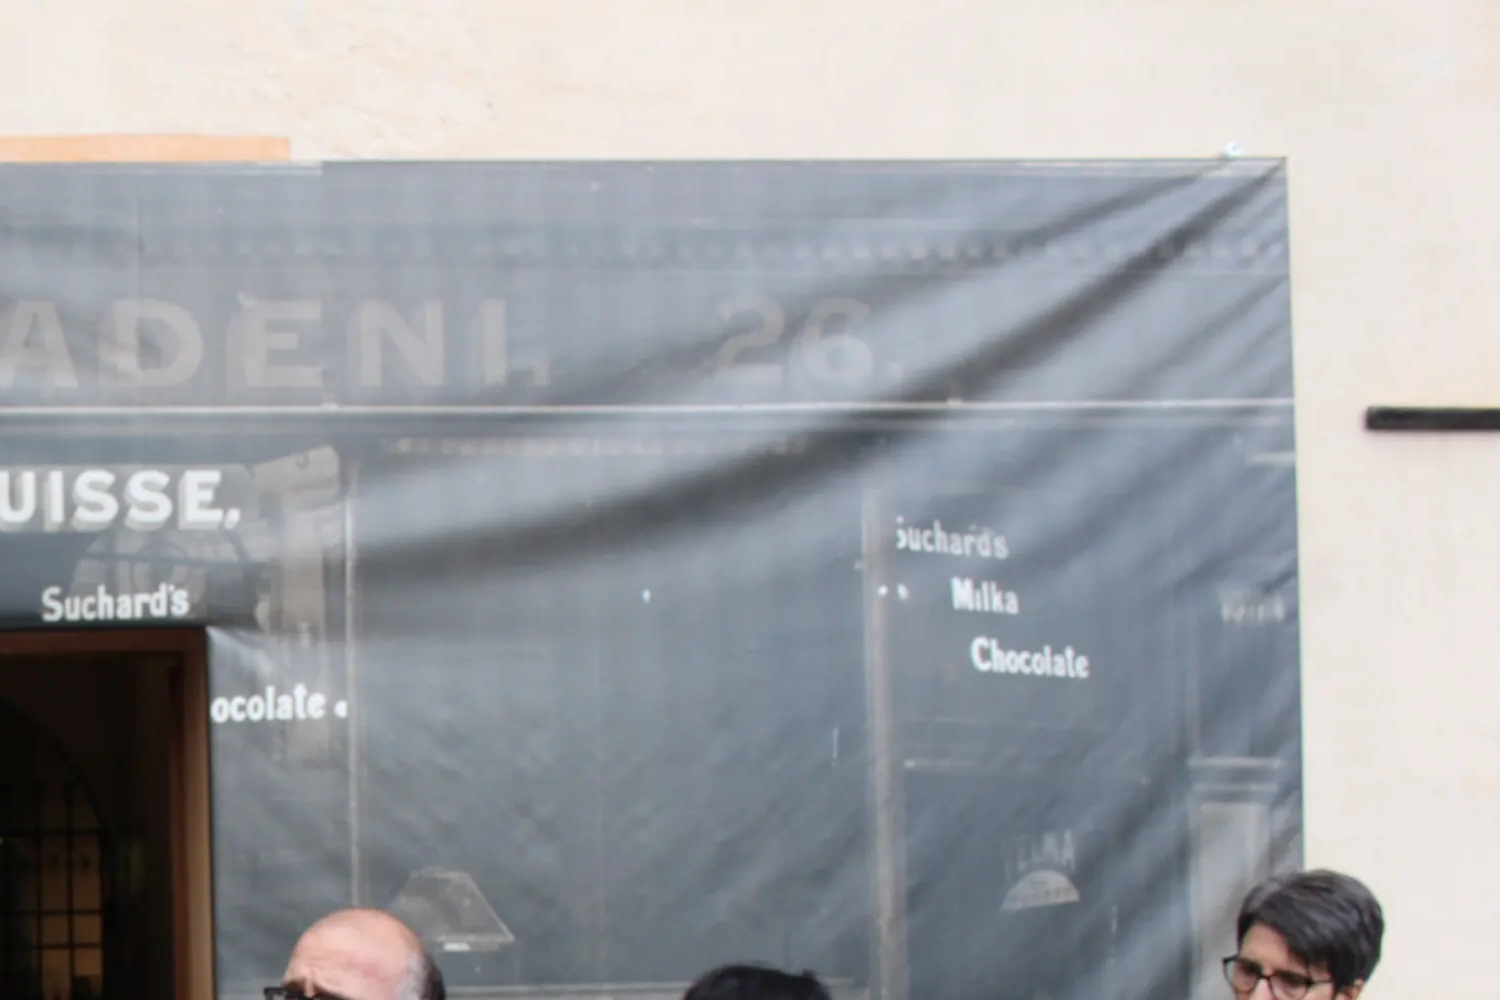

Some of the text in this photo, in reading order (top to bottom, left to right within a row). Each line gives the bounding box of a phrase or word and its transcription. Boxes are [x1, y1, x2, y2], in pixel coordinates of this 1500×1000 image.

[41, 582, 191, 622] Suchard's
[950, 575, 1020, 615] Milka
[968, 635, 1092, 679] Chocolate
